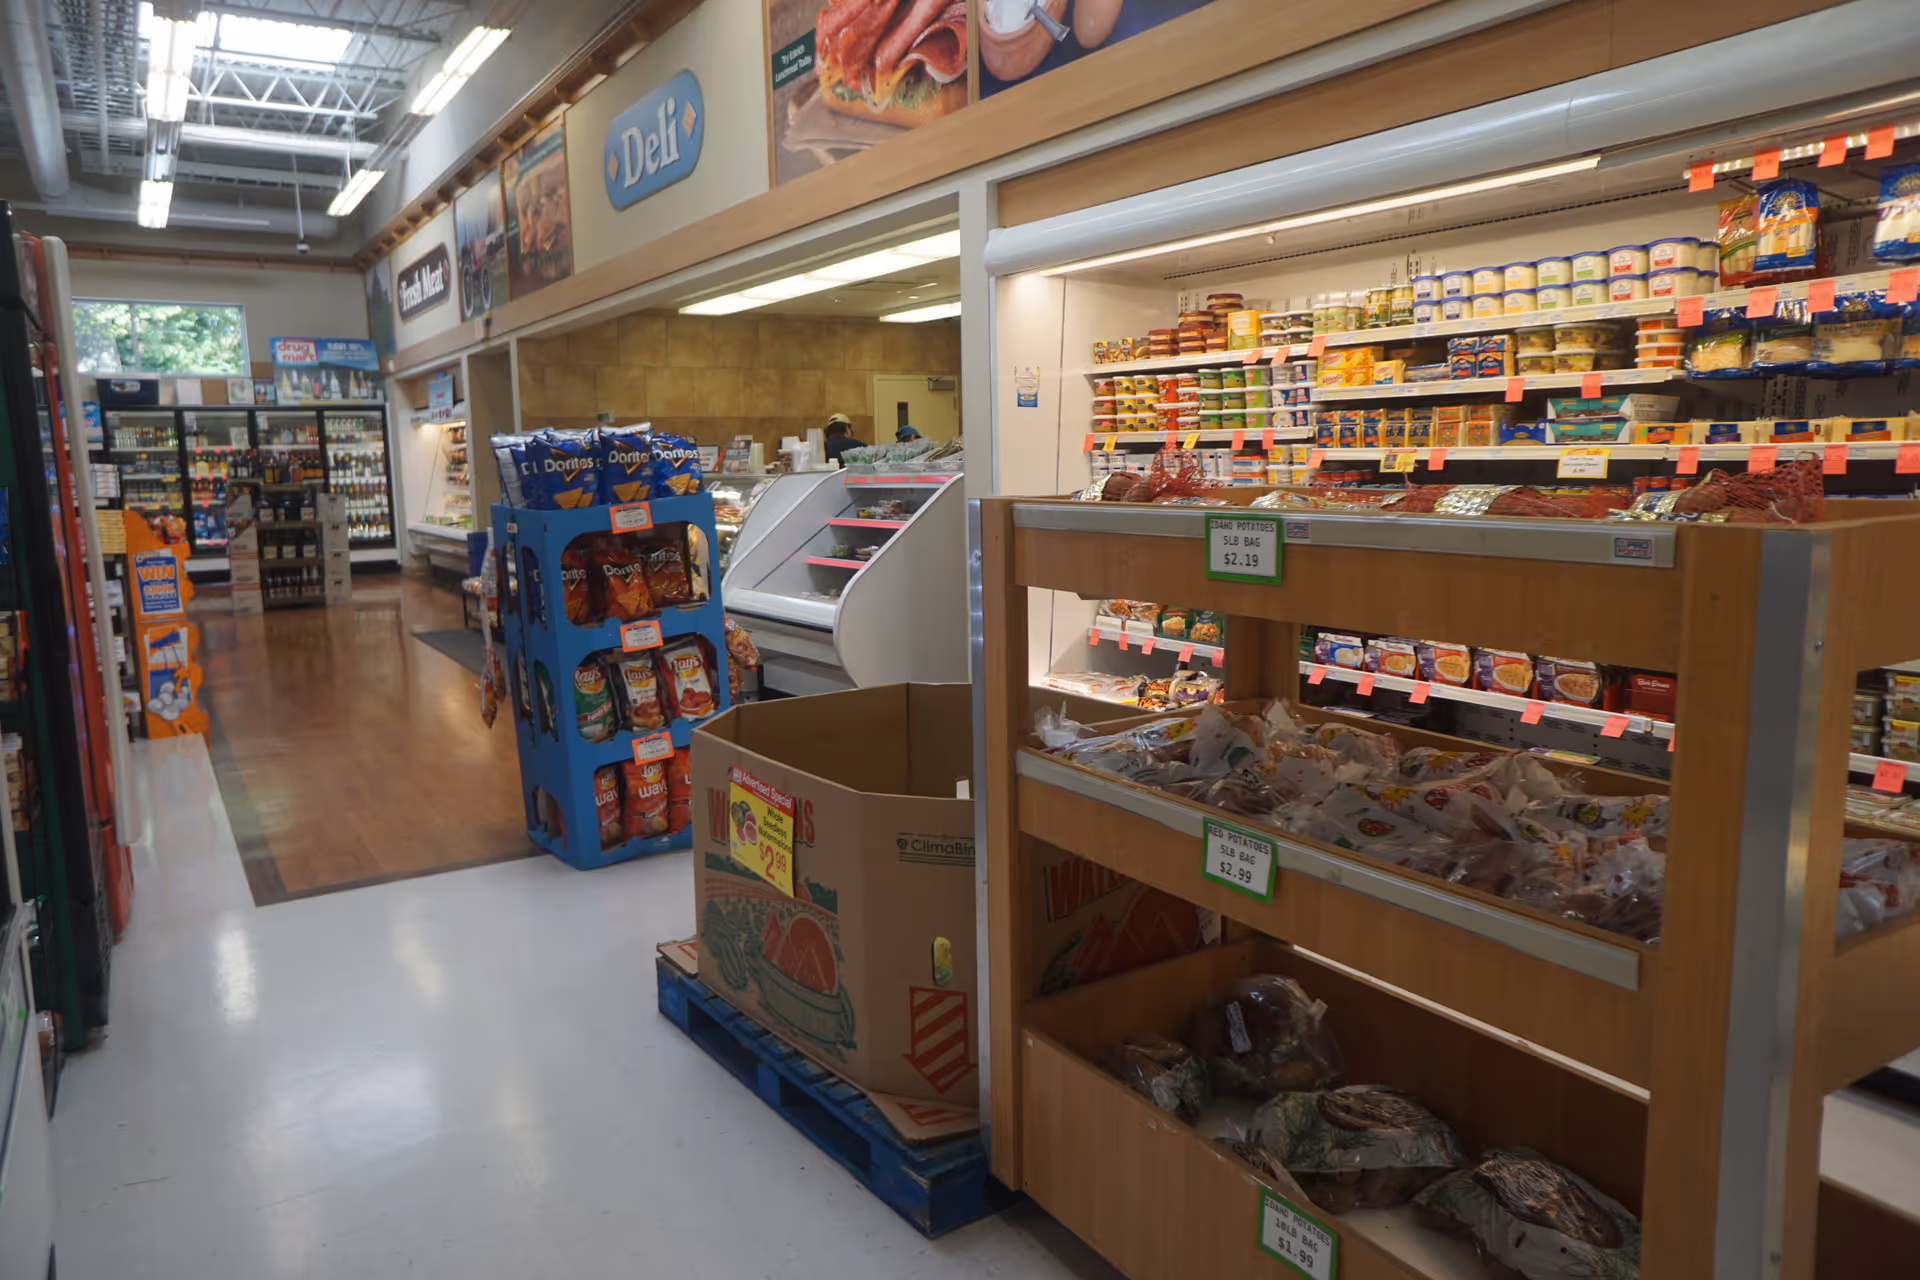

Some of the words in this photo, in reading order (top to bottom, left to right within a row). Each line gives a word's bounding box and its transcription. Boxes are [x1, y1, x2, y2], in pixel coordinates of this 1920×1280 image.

[621, 96, 680, 189] Deli
[401, 269, 422, 312] Fresh
[422, 260, 444, 301] Meat
[277, 339, 311, 356] drug
[281, 349, 319, 362] mart
[608, 449, 650, 464] Dorito
[652, 448, 698, 461] Doritos
[544, 456, 594, 473] Doritos
[1211, 521, 1232, 531] IDAHO
[1237, 521, 1275, 533] POTATOES
[1223, 535, 1240, 546] 5LB
[1244, 537, 1261, 547] BAG
[1224, 552, 1259, 567] $2.19
[137, 564, 175, 582] WIN
[673, 656, 700, 673] Lay's
[742, 772, 771, 798] Advertised
[770, 787, 793, 809] Special
[766, 806, 784, 824] Whole
[763, 815, 788, 839] Seedless
[1207, 824, 1224, 838] RED
[1227, 832, 1269, 855] POTATOES
[1220, 843, 1236, 857] 5LB
[1239, 851, 1256, 865] BAG
[1219, 861, 1252, 884] $2.99
[1265, 1198, 1290, 1218] IDAHO
[1293, 1213, 1331, 1247] POTATOES
[1275, 1217, 1298, 1238] 10LB
[1302, 1234, 1319, 1253] BAG
[1278, 1236, 1314, 1269] $1.99
